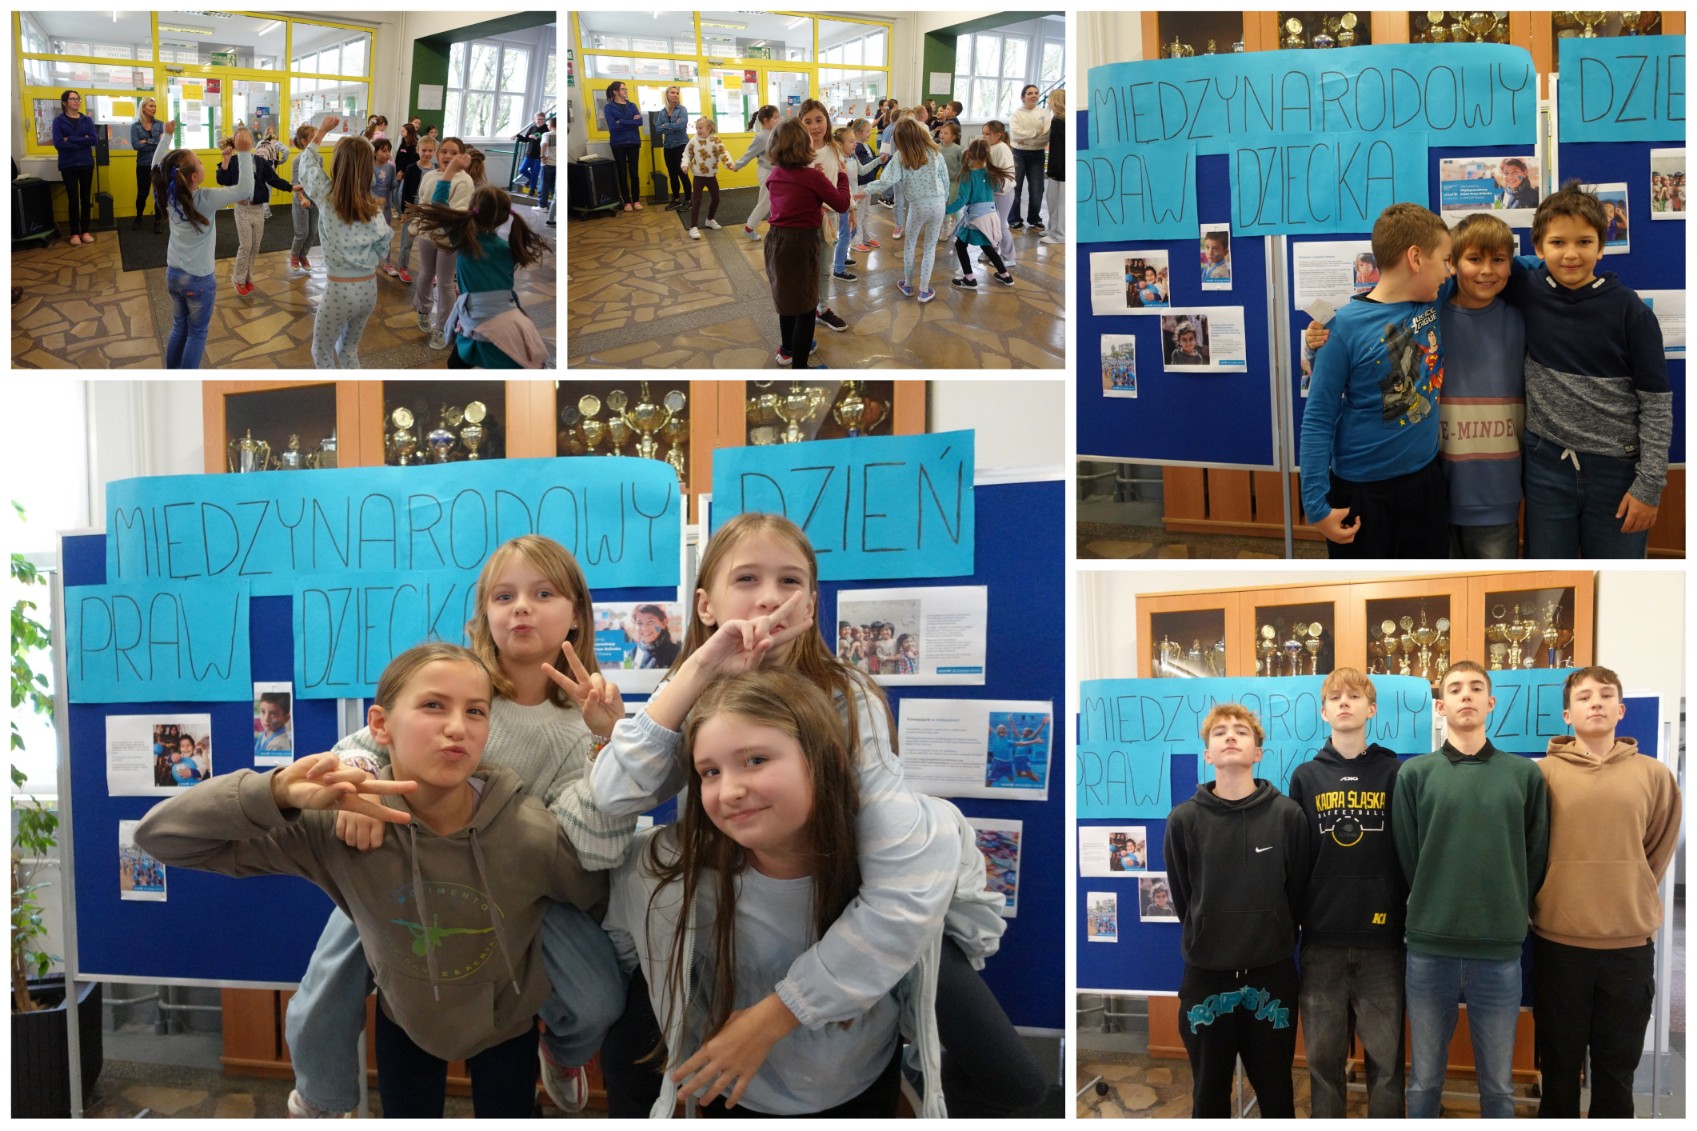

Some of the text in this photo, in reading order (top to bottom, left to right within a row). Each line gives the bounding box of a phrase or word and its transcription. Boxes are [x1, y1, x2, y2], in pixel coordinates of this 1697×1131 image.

[1236, 140, 1395, 228] DZIECKA
[1438, 419, 1515, 440] E-MINDE
[80, 592, 240, 682] PRAW
[1485, 684, 1570, 738] ZIE
[1315, 791, 1345, 812] KADRA
